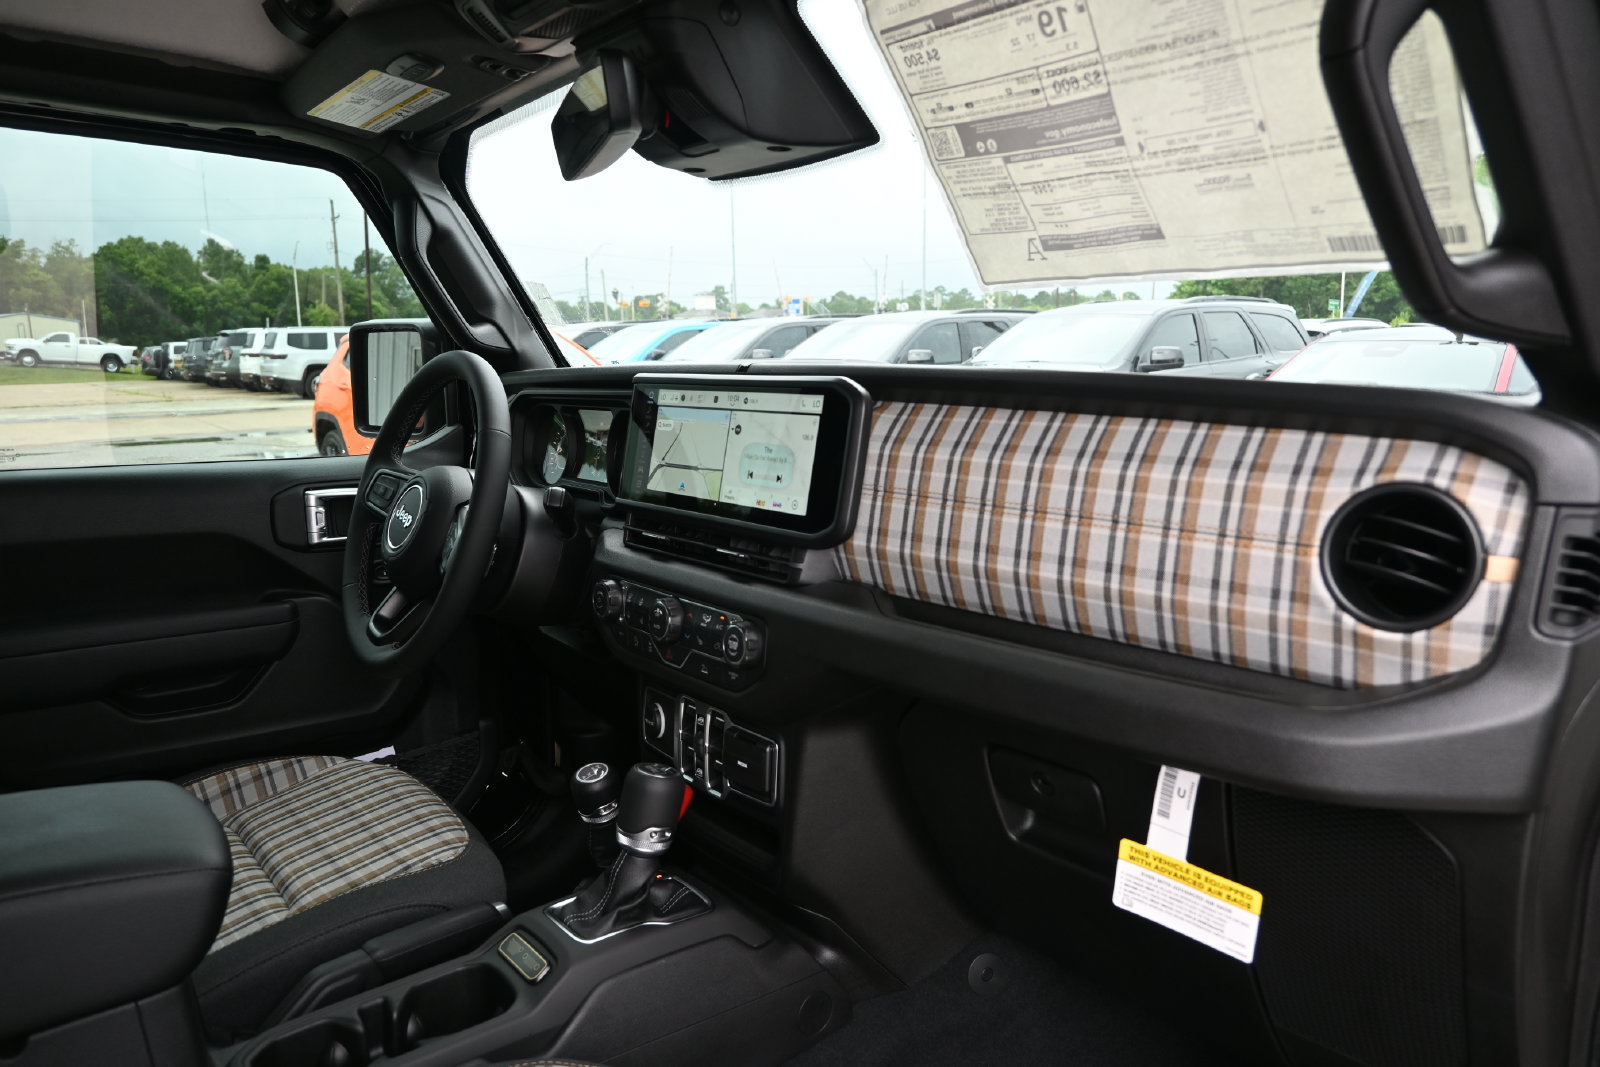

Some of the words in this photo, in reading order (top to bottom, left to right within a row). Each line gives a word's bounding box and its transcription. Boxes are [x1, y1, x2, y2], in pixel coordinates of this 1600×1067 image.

[395, 504, 414, 529] Jeep
[1129, 846, 1149, 859] THIS
[1152, 855, 1189, 875] VEHICLE
[1193, 871, 1202, 880] IS
[1204, 876, 1254, 901] EQUIPPED
[1129, 854, 1152, 868] WITH
[1154, 864, 1205, 890] ADVANCED
[1207, 886, 1223, 897] AIR
[1226, 894, 1252, 910] BAGS
